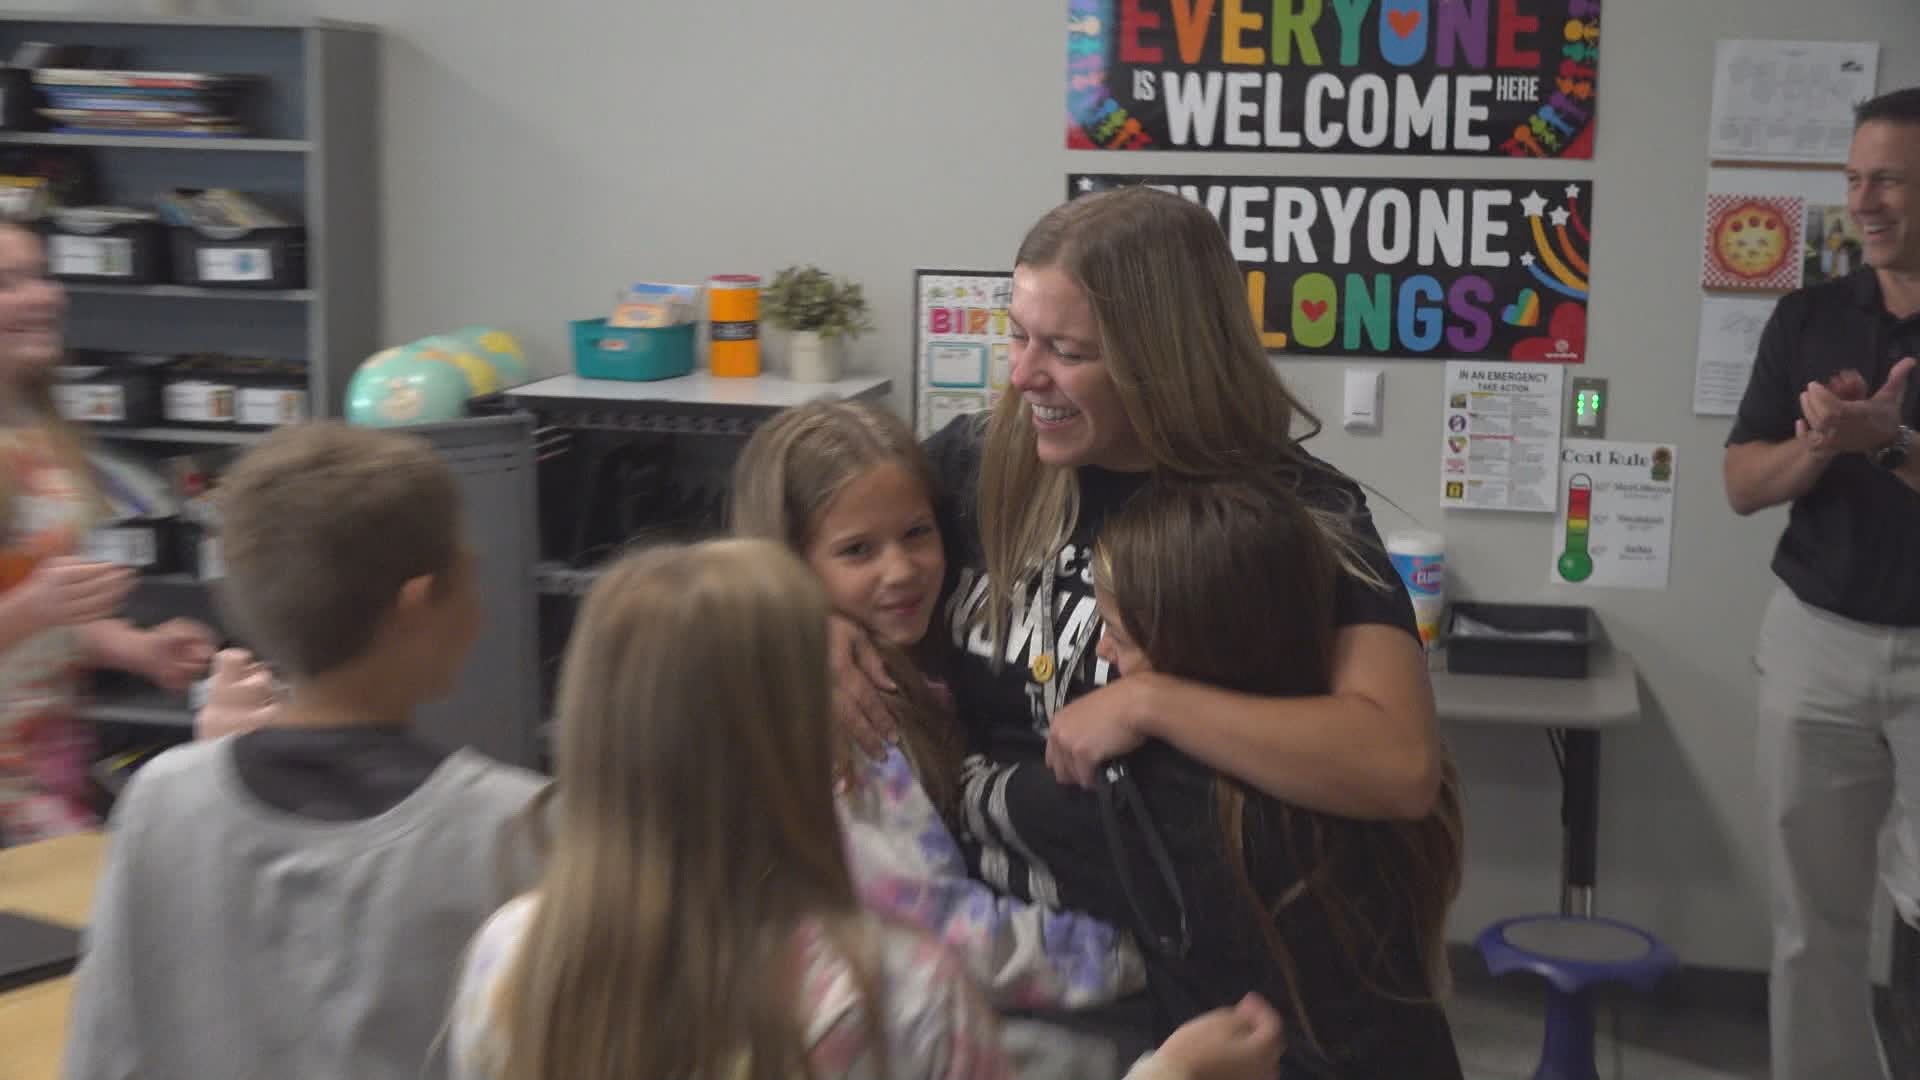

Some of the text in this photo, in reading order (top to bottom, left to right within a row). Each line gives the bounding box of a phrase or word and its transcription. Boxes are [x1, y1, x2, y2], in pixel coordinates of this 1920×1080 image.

[1118, 0, 1542, 68] EVERYONE
[1132, 69, 1541, 151] IS WELCOME HERE
[1149, 184, 1512, 268] ERYONE
[929, 308, 1008, 335] BIRT
[1247, 271, 1495, 353] LONGS
[1458, 369, 1548, 383] IN AN EMERGENCY
